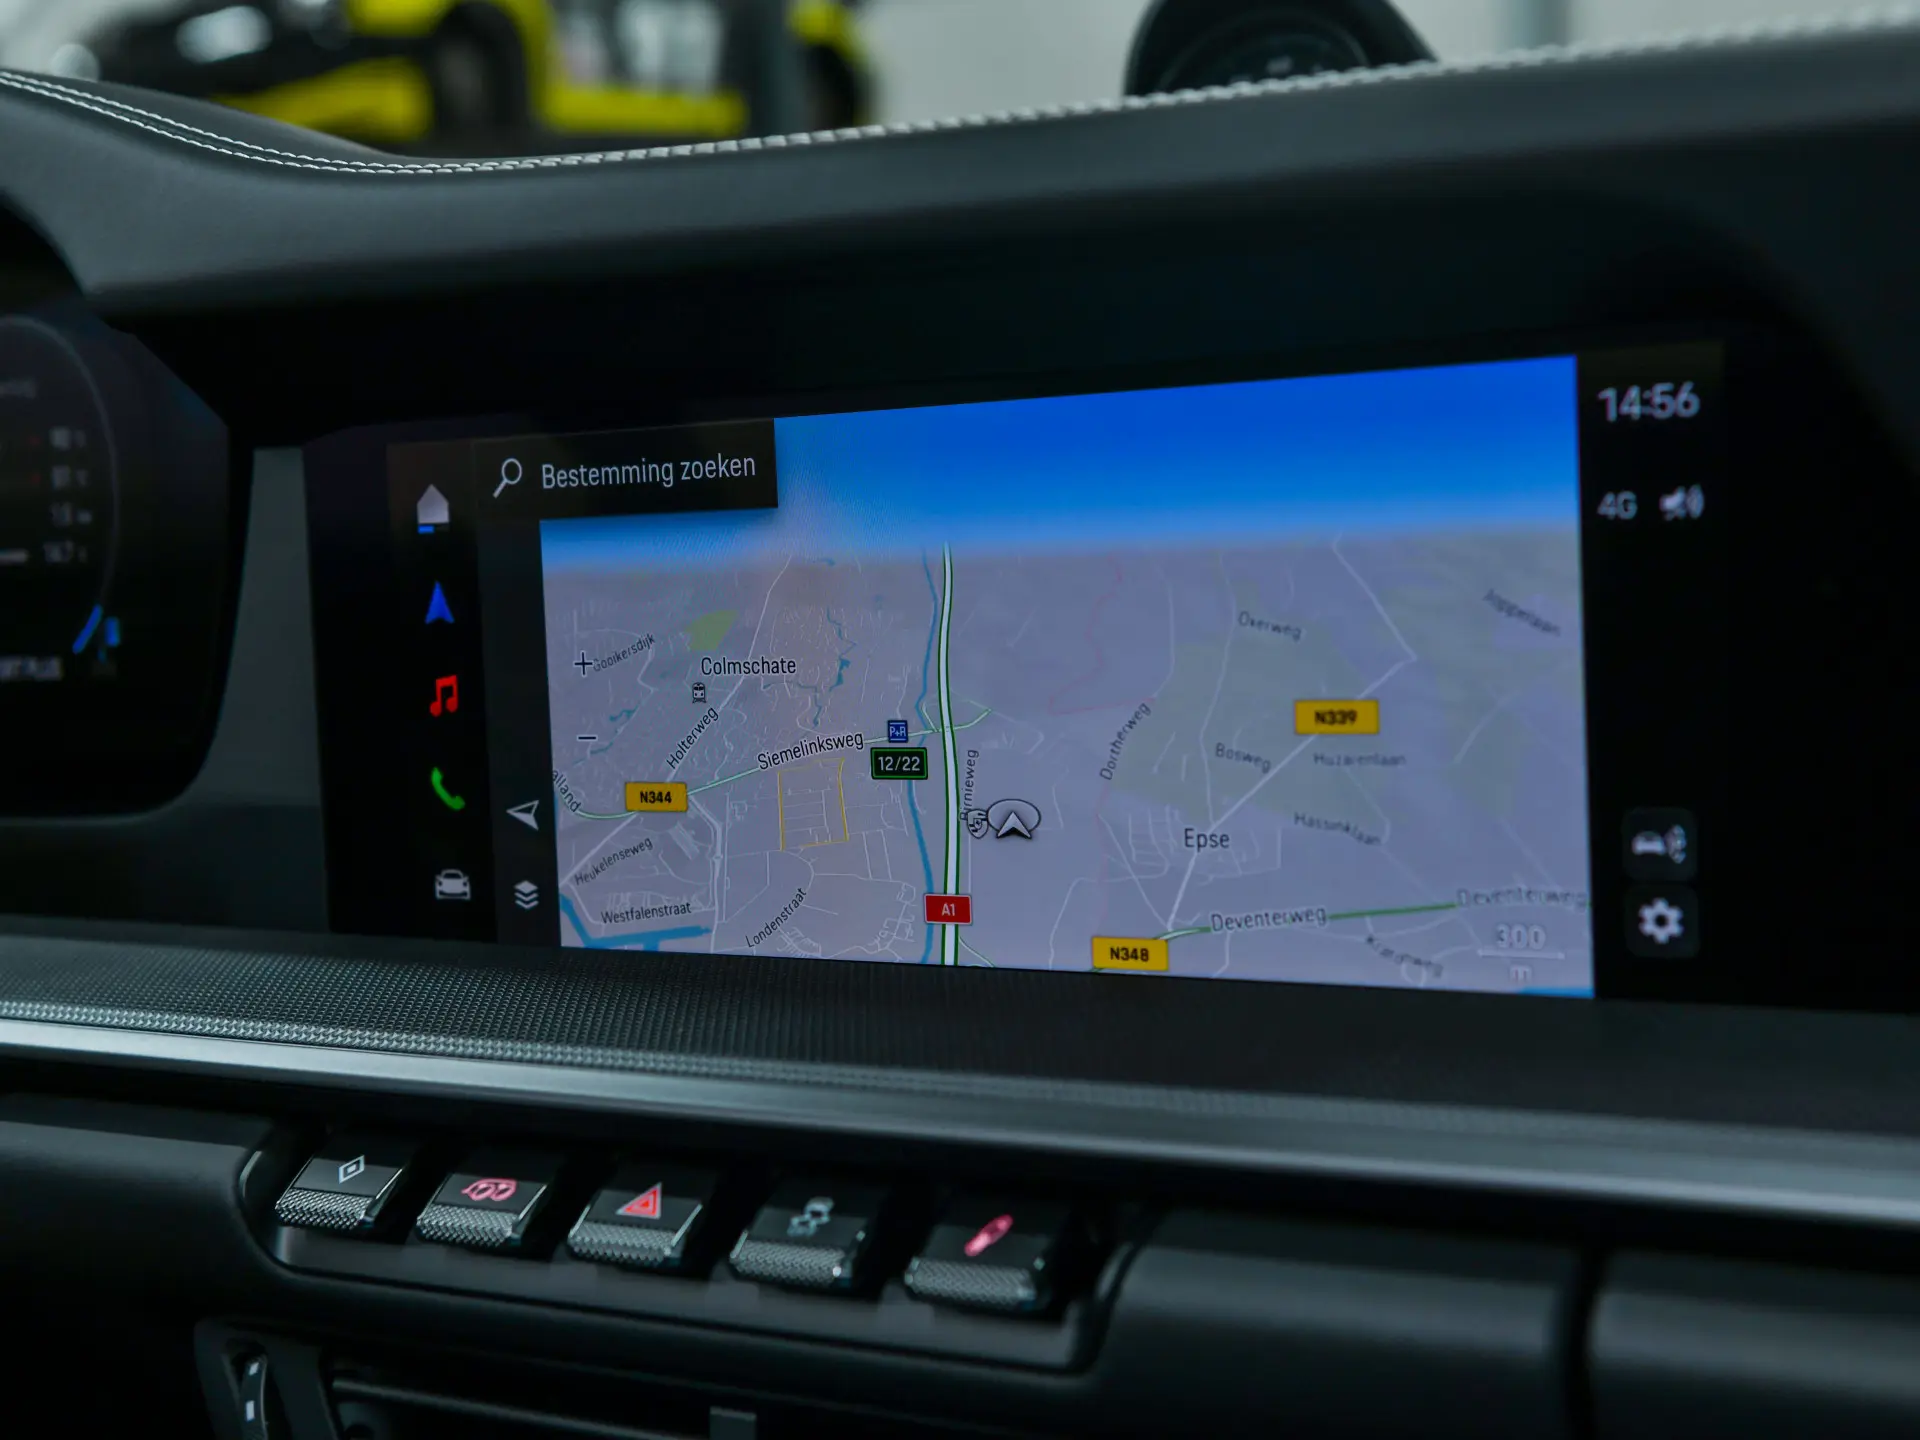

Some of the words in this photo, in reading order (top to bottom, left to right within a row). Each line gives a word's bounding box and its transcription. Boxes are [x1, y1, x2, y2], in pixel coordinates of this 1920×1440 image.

[1597, 381, 1701, 423] 14:56
[541, 458, 674, 488] Bestemming
[680, 453, 756, 481] zoeken
[1597, 491, 1638, 520] 4G
[592, 632, 656, 673] Gooikersdijk
[701, 656, 797, 676] Colmschate
[1314, 709, 1358, 726] N339
[665, 706, 719, 770] Holterweg
[890, 726, 907, 737] P+R
[1099, 701, 1151, 781] Dortherweg
[757, 732, 864, 770] Siemelinksweg
[878, 756, 921, 771] 12/22
[1214, 742, 1272, 774] Bosweg
[639, 790, 673, 805] N344
[1184, 828, 1230, 852] Epse
[574, 836, 654, 887] Heukelenseweg
[601, 901, 692, 924] Westfalenstraat
[745, 886, 807, 948] Londenstraat
[941, 902, 956, 917] A1
[1210, 906, 1328, 933] Deventerweg
[1496, 923, 1547, 950] 300
[1109, 946, 1150, 962] N348
